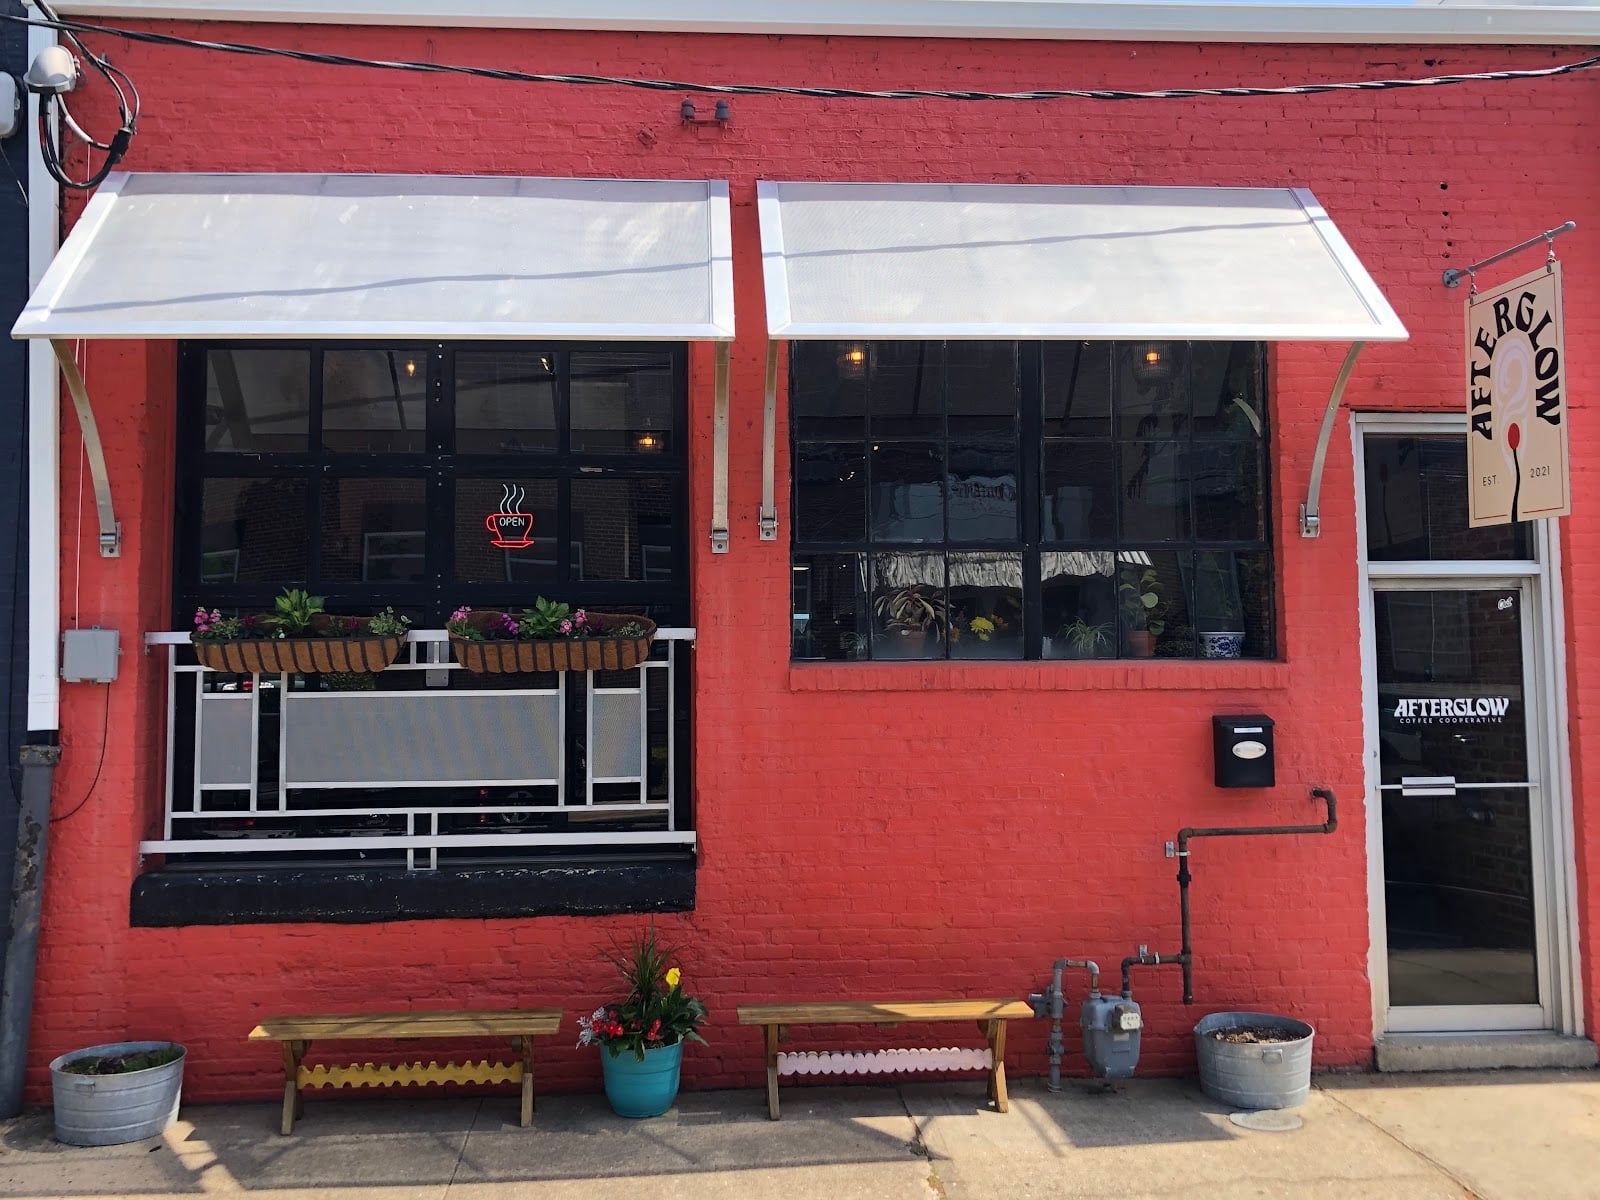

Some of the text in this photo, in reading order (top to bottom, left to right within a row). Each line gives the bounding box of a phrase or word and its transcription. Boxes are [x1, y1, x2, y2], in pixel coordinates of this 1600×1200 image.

[1471, 291, 1561, 441] AFTERGLOW
[1530, 465, 1550, 478] 2021
[499, 516, 525, 527] OPEN
[1393, 698, 1509, 717] AFTERGLOW
